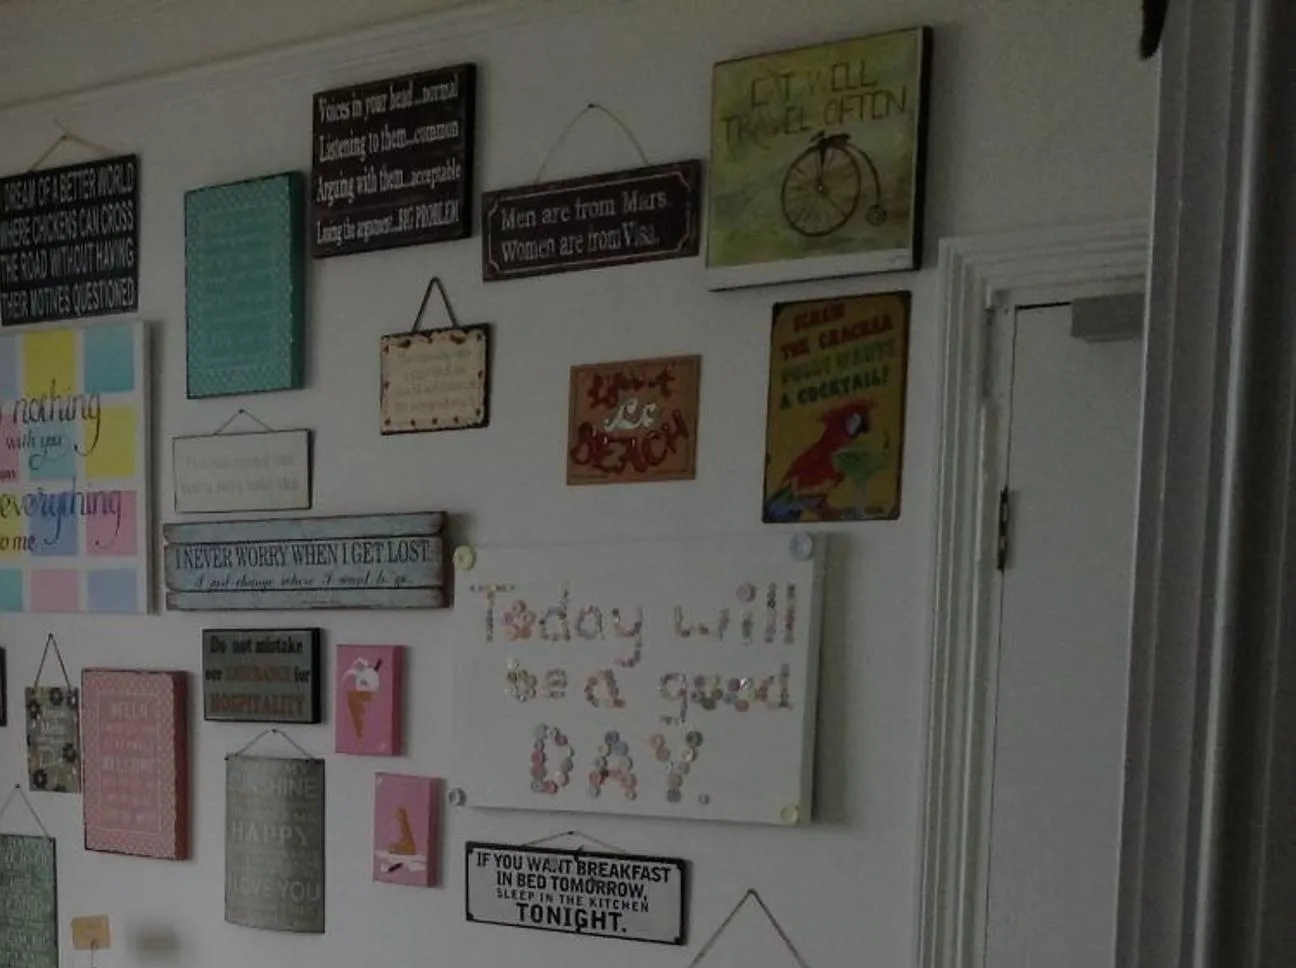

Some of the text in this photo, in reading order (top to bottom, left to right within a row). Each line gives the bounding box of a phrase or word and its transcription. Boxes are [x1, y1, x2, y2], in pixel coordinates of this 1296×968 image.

[319, 97, 350, 123] Voices
[352, 91, 363, 120] in
[364, 93, 388, 121] your
[319, 128, 367, 163] Listening
[368, 132, 380, 153] to
[59, 168, 97, 204] BETTER
[97, 162, 134, 197] WORLD
[316, 169, 355, 207] Arguing
[356, 165, 378, 194] with
[101, 199, 135, 235] CROSS
[501, 206, 536, 232] Men
[542, 205, 571, 225] are
[575, 196, 617, 221] from
[20, 248, 48, 280] ROAD
[50, 243, 94, 277] WITHOUT
[95, 237, 135, 272] HAVING
[501, 238, 555, 263] Women
[560, 233, 585, 256] are
[587, 224, 622, 254] from
[29, 284, 70, 317] MOTIVES
[72, 276, 135, 317] QUESTIONED
[12, 378, 102, 456] nothing
[5, 430, 35, 451] with
[12, 533, 37, 551] me
[175, 548, 181, 569] I
[183, 545, 233, 570] NEVER
[235, 543, 289, 568] WORRY
[291, 541, 340, 566] WHEN
[342, 541, 350, 565] I
[351, 539, 384, 565] GET
[470, 581, 643, 668] Today
[210, 635, 227, 653] Do
[506, 657, 793, 725] be a good
[231, 820, 314, 848] HAPPY
[476, 851, 672, 884] IF YOU WANT BREAKFAST
[279, 879, 322, 903] YOU
[496, 888, 650, 913] SLEEP IN THE KITCHEN
[497, 870, 648, 901] IN BED TOMORROW,
[515, 902, 628, 934] TONIGHT.
